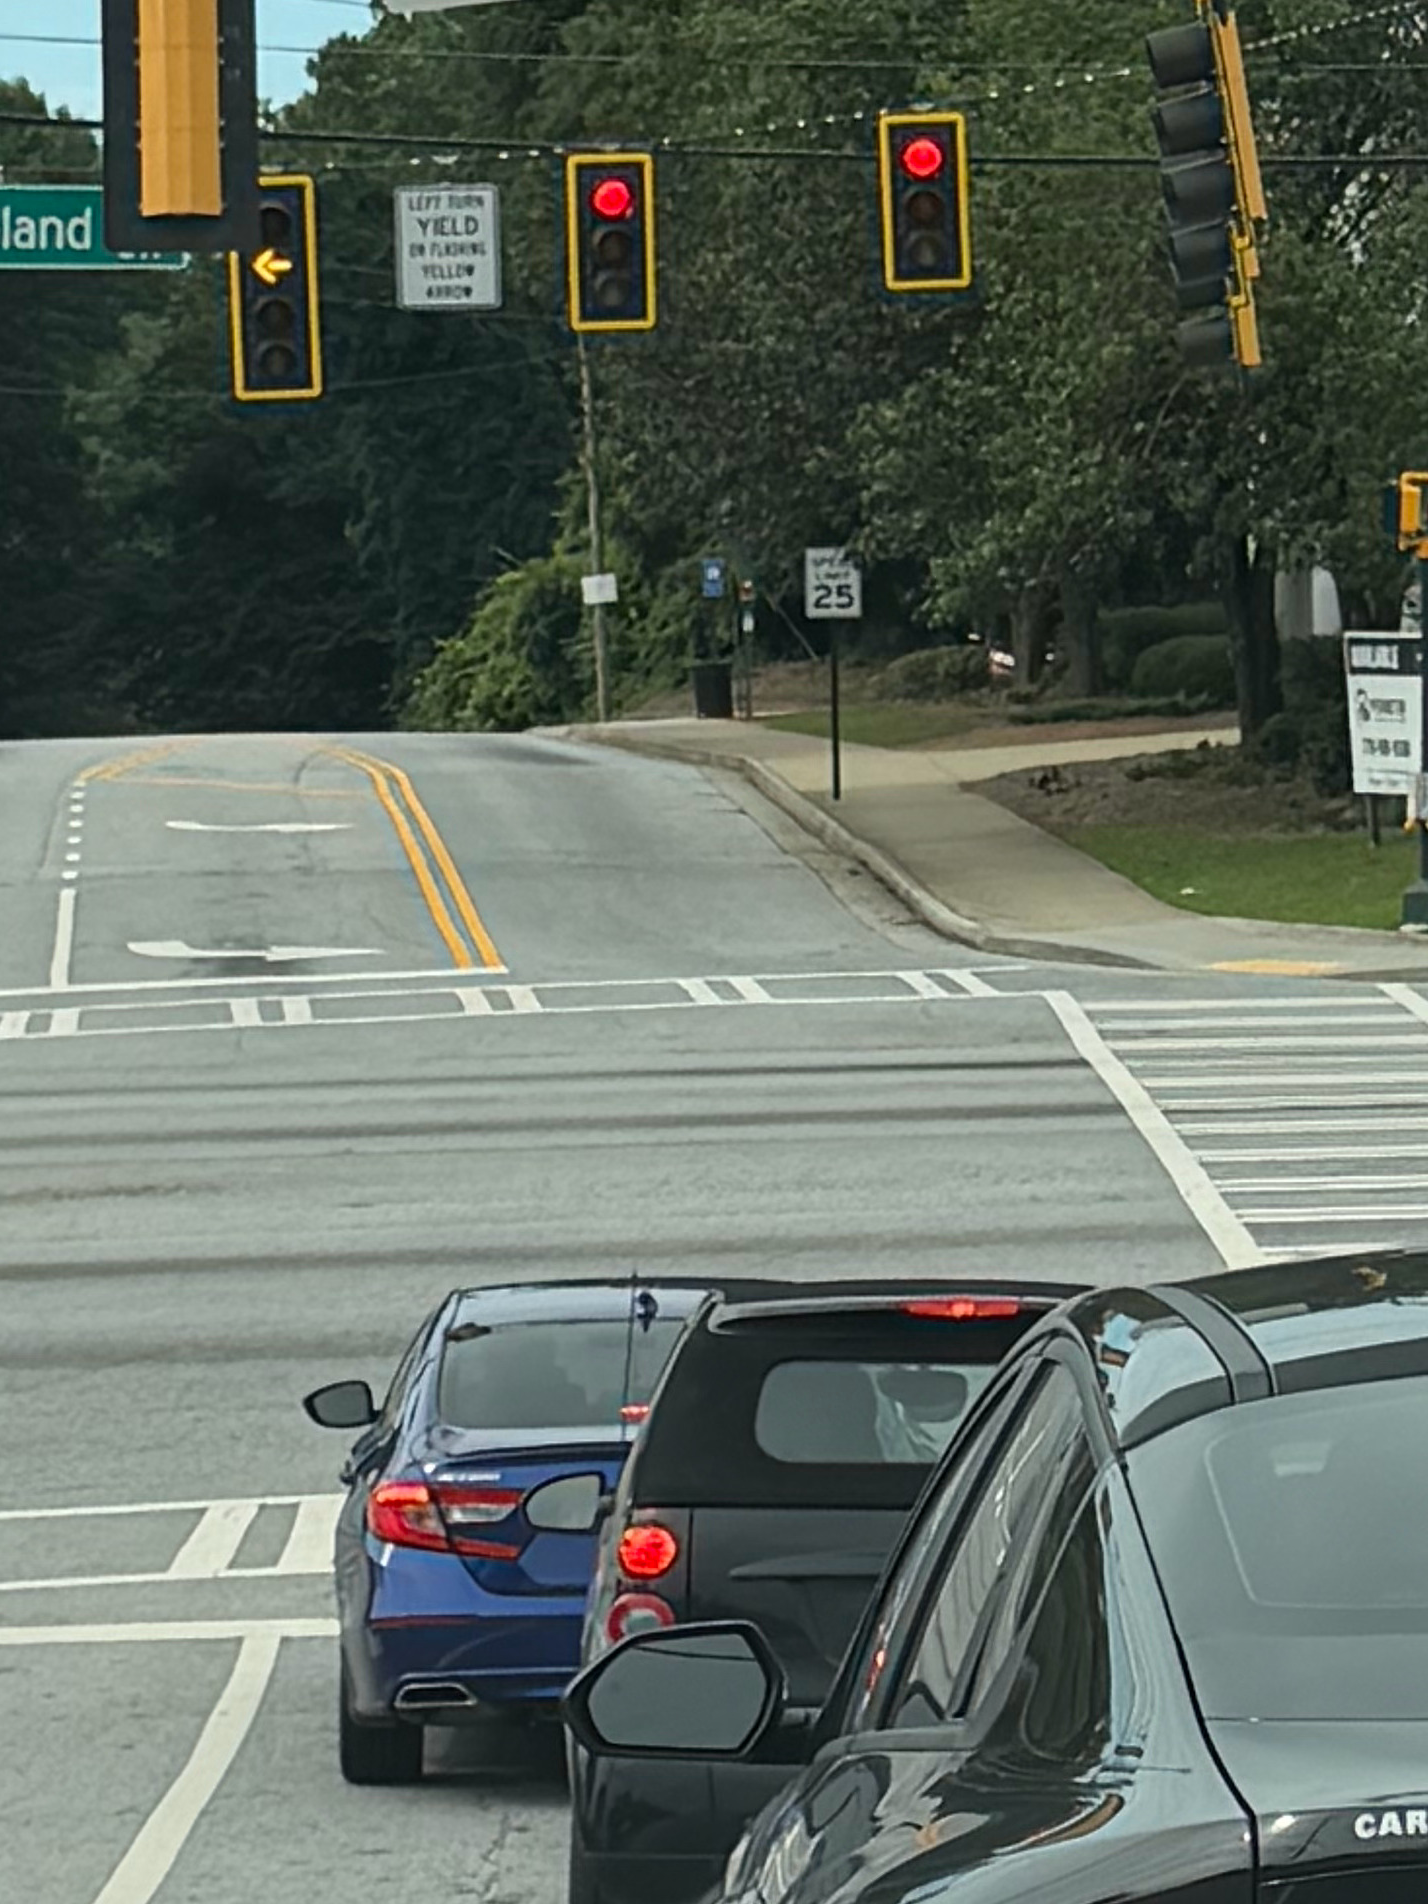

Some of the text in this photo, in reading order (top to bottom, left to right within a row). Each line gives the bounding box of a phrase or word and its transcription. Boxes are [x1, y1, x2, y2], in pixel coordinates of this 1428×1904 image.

[408, 196, 441, 211] LEFT
[417, 215, 479, 236] YIELD
[422, 264, 475, 279] YELLOW
[813, 584, 855, 609] 25
